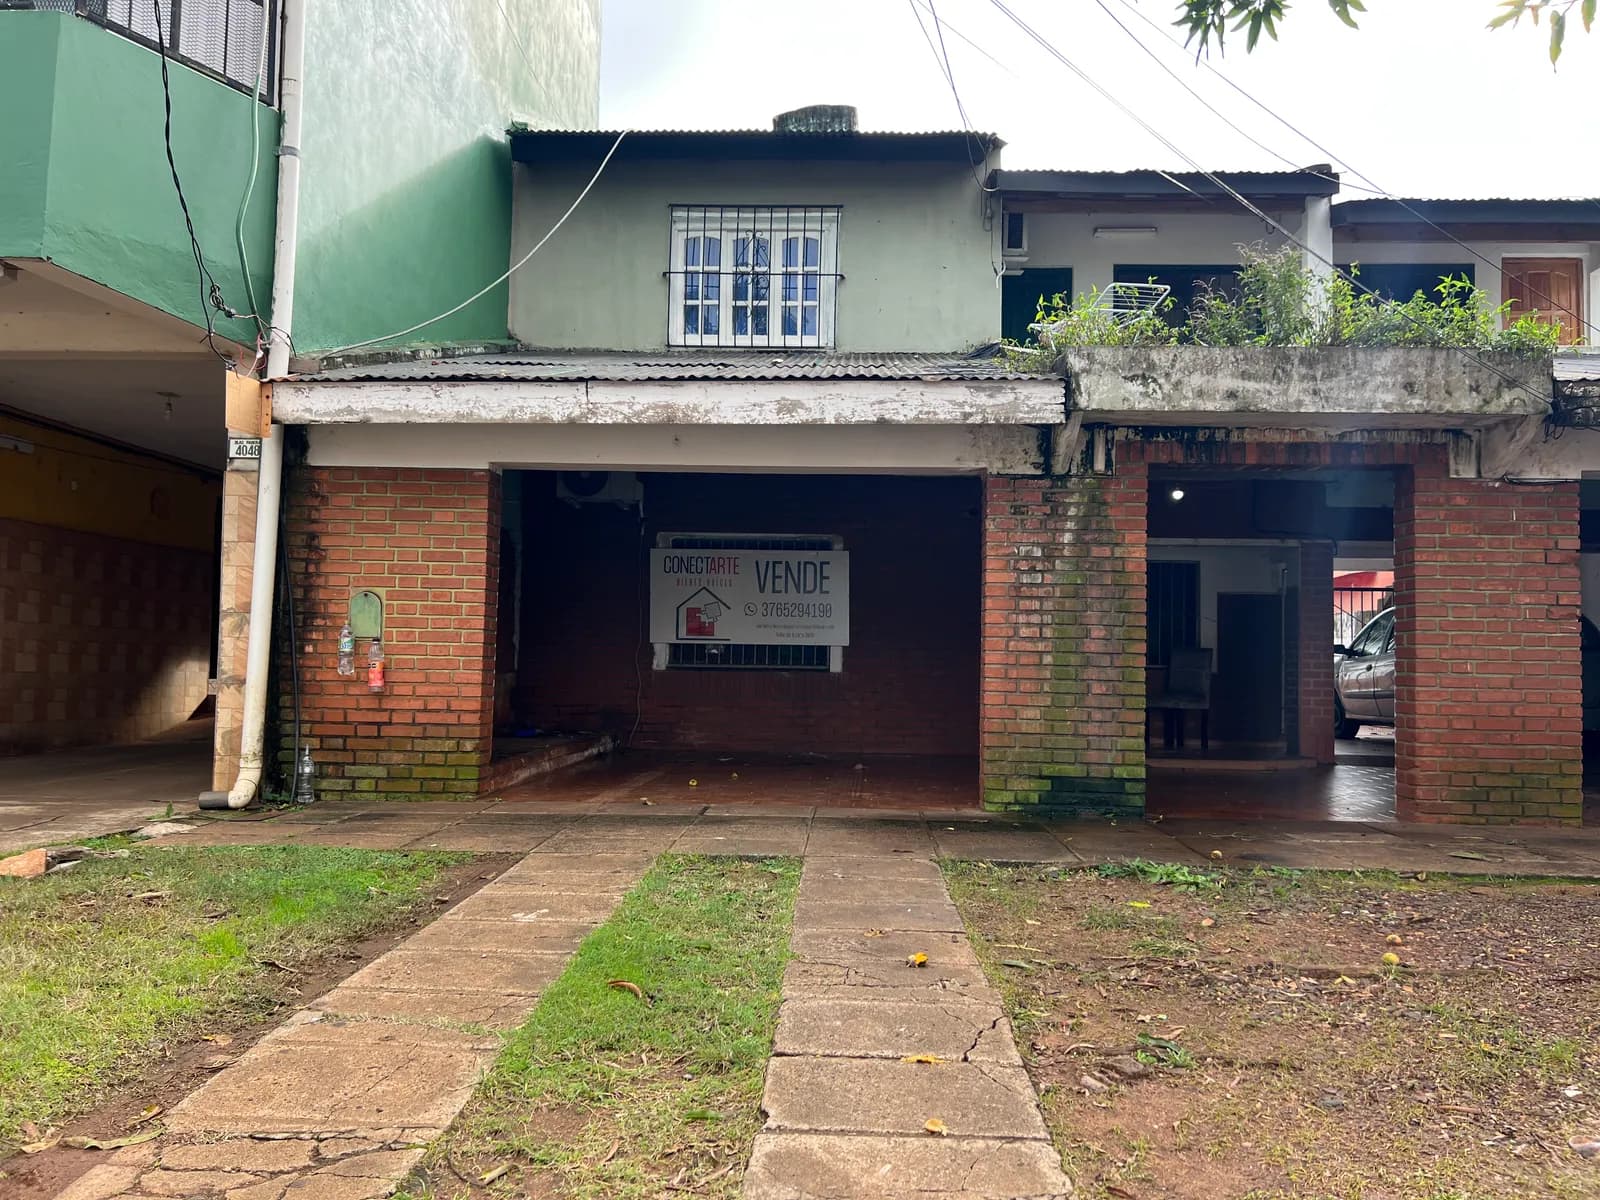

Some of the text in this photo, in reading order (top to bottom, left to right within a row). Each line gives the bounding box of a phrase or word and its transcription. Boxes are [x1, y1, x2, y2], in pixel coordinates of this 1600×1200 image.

[235, 445, 260, 456] 4048
[664, 555, 740, 574] CONECTARTE
[755, 560, 830, 594] VENDE
[761, 602, 832, 618] 3765294190
